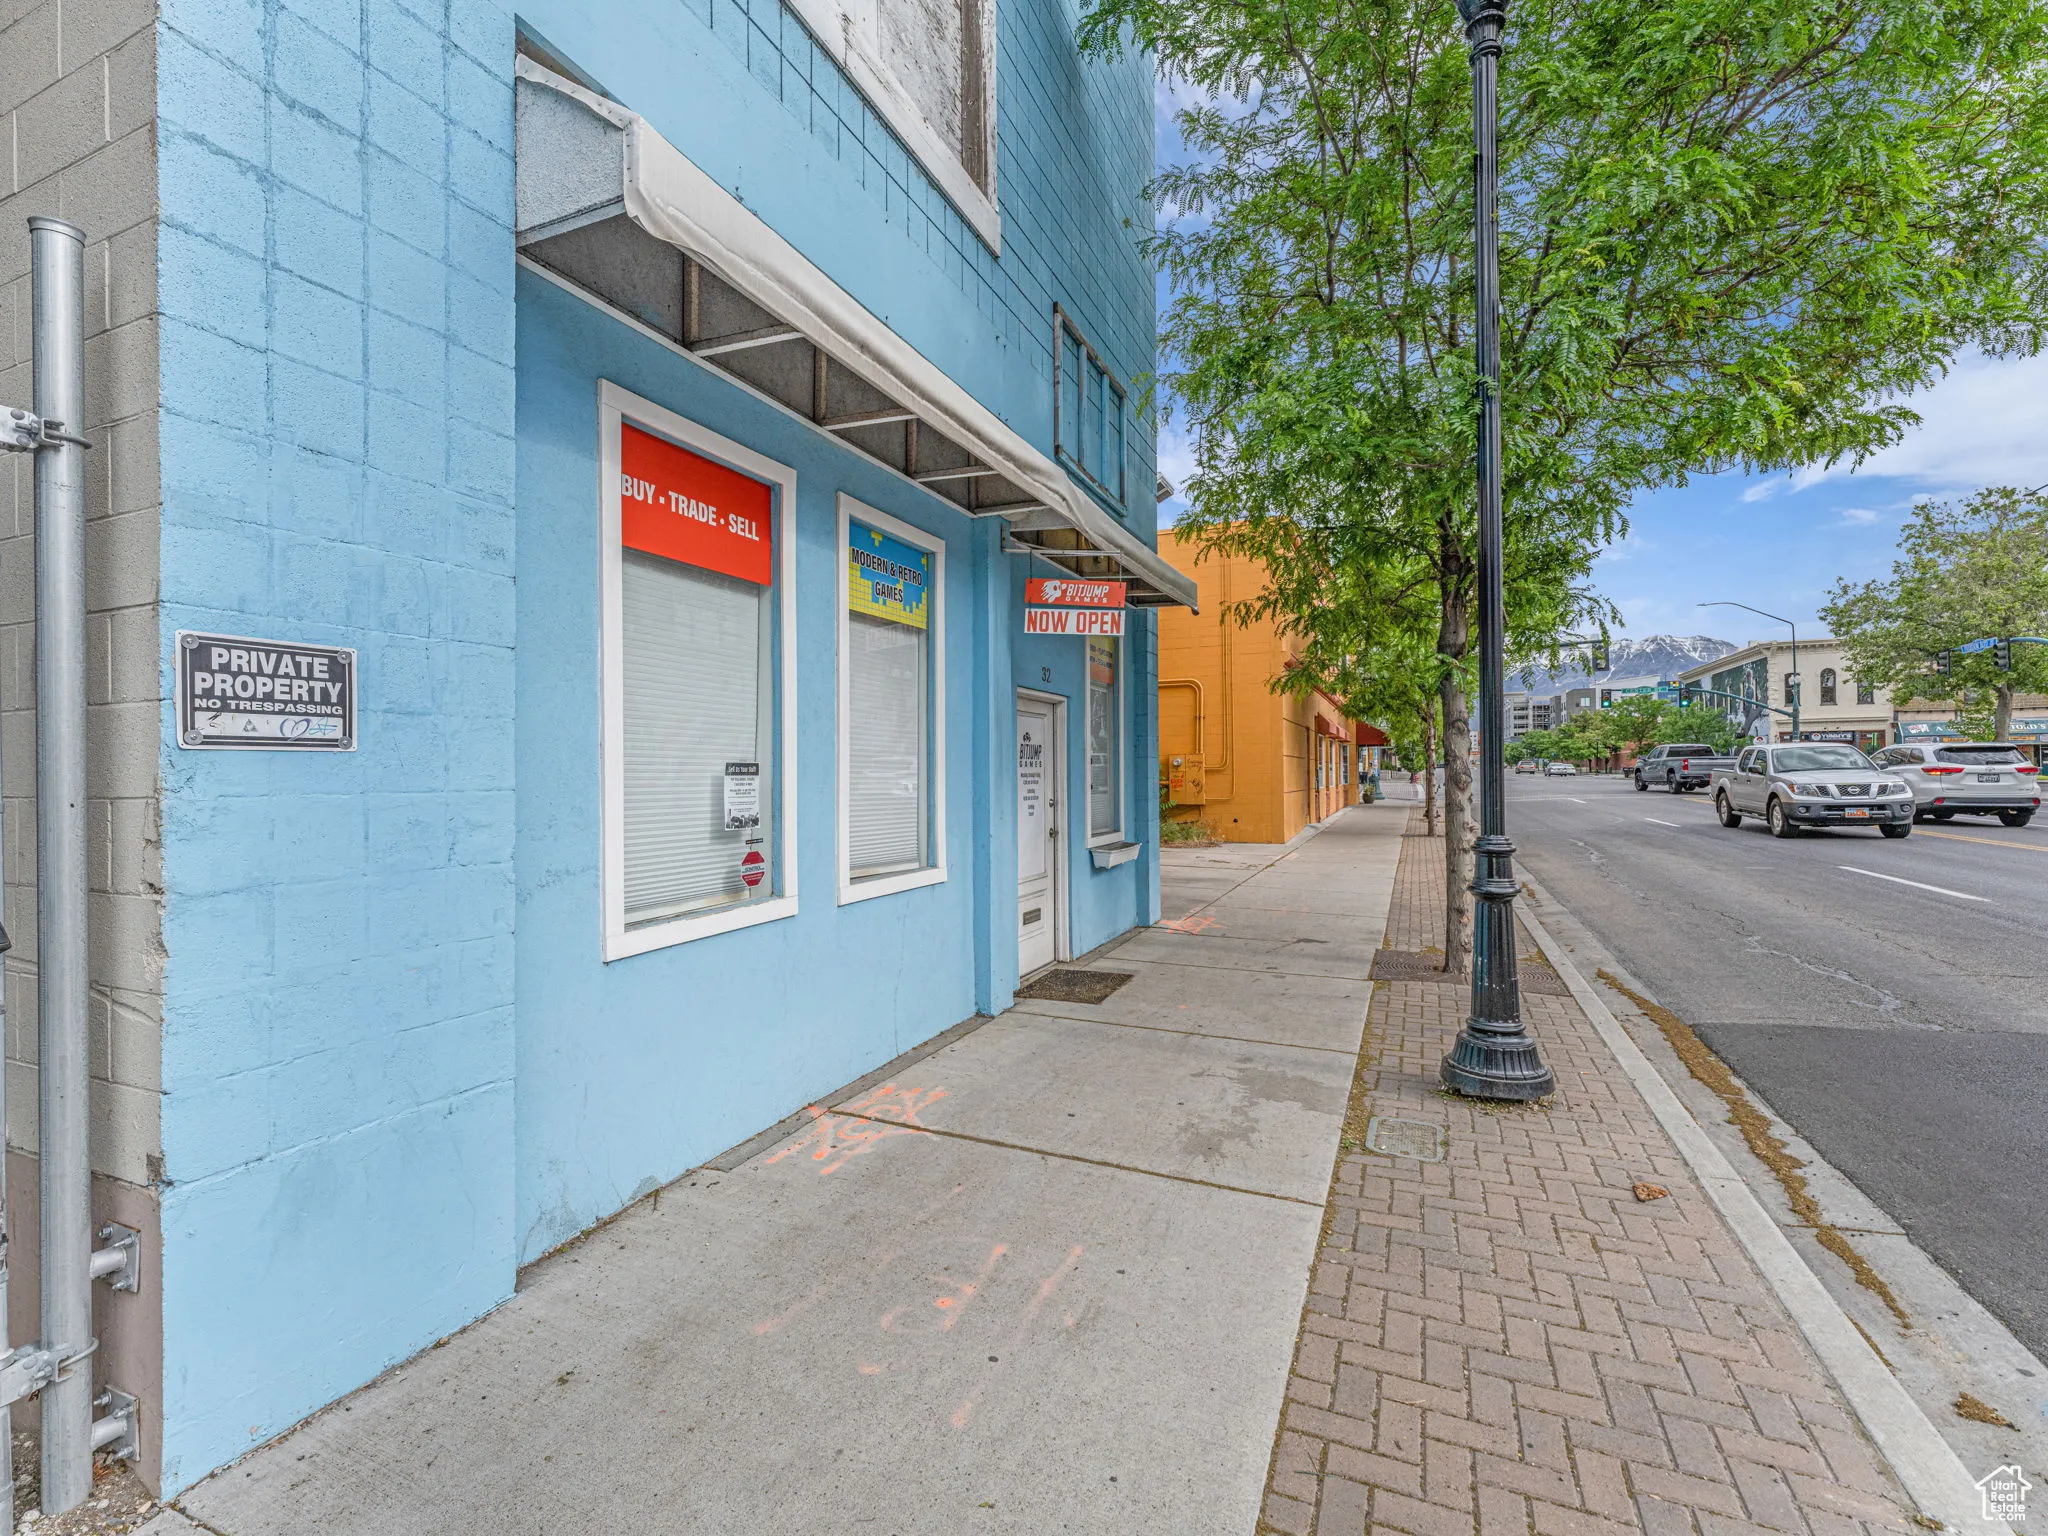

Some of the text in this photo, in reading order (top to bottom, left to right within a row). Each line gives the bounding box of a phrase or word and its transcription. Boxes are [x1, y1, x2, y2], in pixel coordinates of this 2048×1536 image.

[622, 474, 760, 541] BUY TRADE SELL
[851, 547, 923, 586] MODERN & RETRO
[875, 580, 904, 603] GAMES
[1066, 583, 1109, 598] BITJUMP
[1026, 611, 1120, 634] NOW OPEN
[211, 647, 330, 679] PRIVATE
[1041, 666, 1052, 683] 32
[194, 671, 343, 703] PROPERTY
[194, 698, 343, 715] NO TRESPASSING
[1020, 744, 1042, 760] BITJUMP
